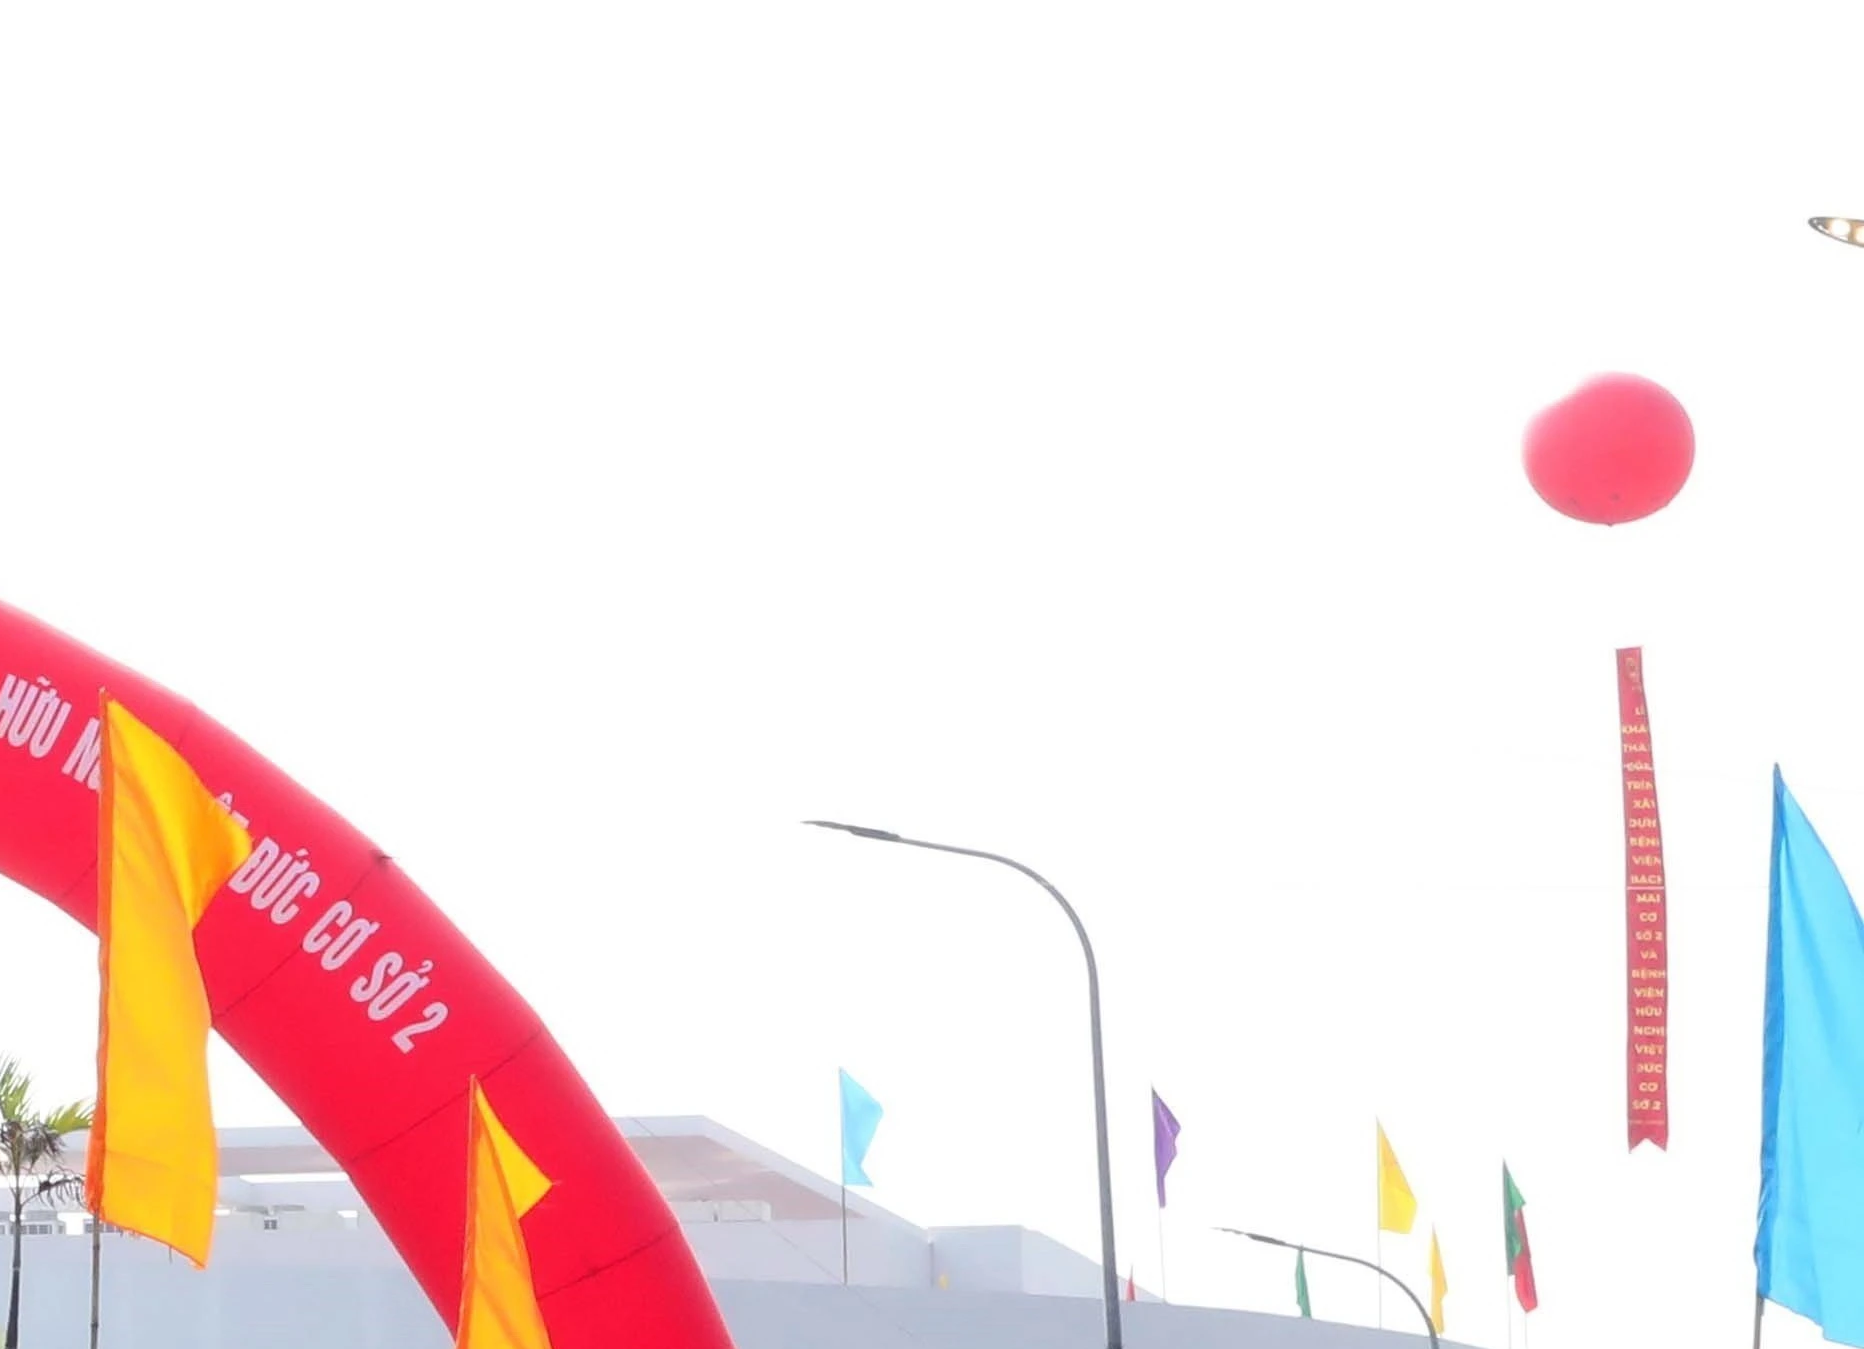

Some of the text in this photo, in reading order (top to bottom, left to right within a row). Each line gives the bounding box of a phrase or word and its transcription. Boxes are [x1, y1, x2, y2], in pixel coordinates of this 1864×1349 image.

[228, 836, 320, 924] ĐỨC
[303, 900, 380, 970] CƠ
[350, 952, 433, 1021] SỞ
[391, 1002, 448, 1054] 2
